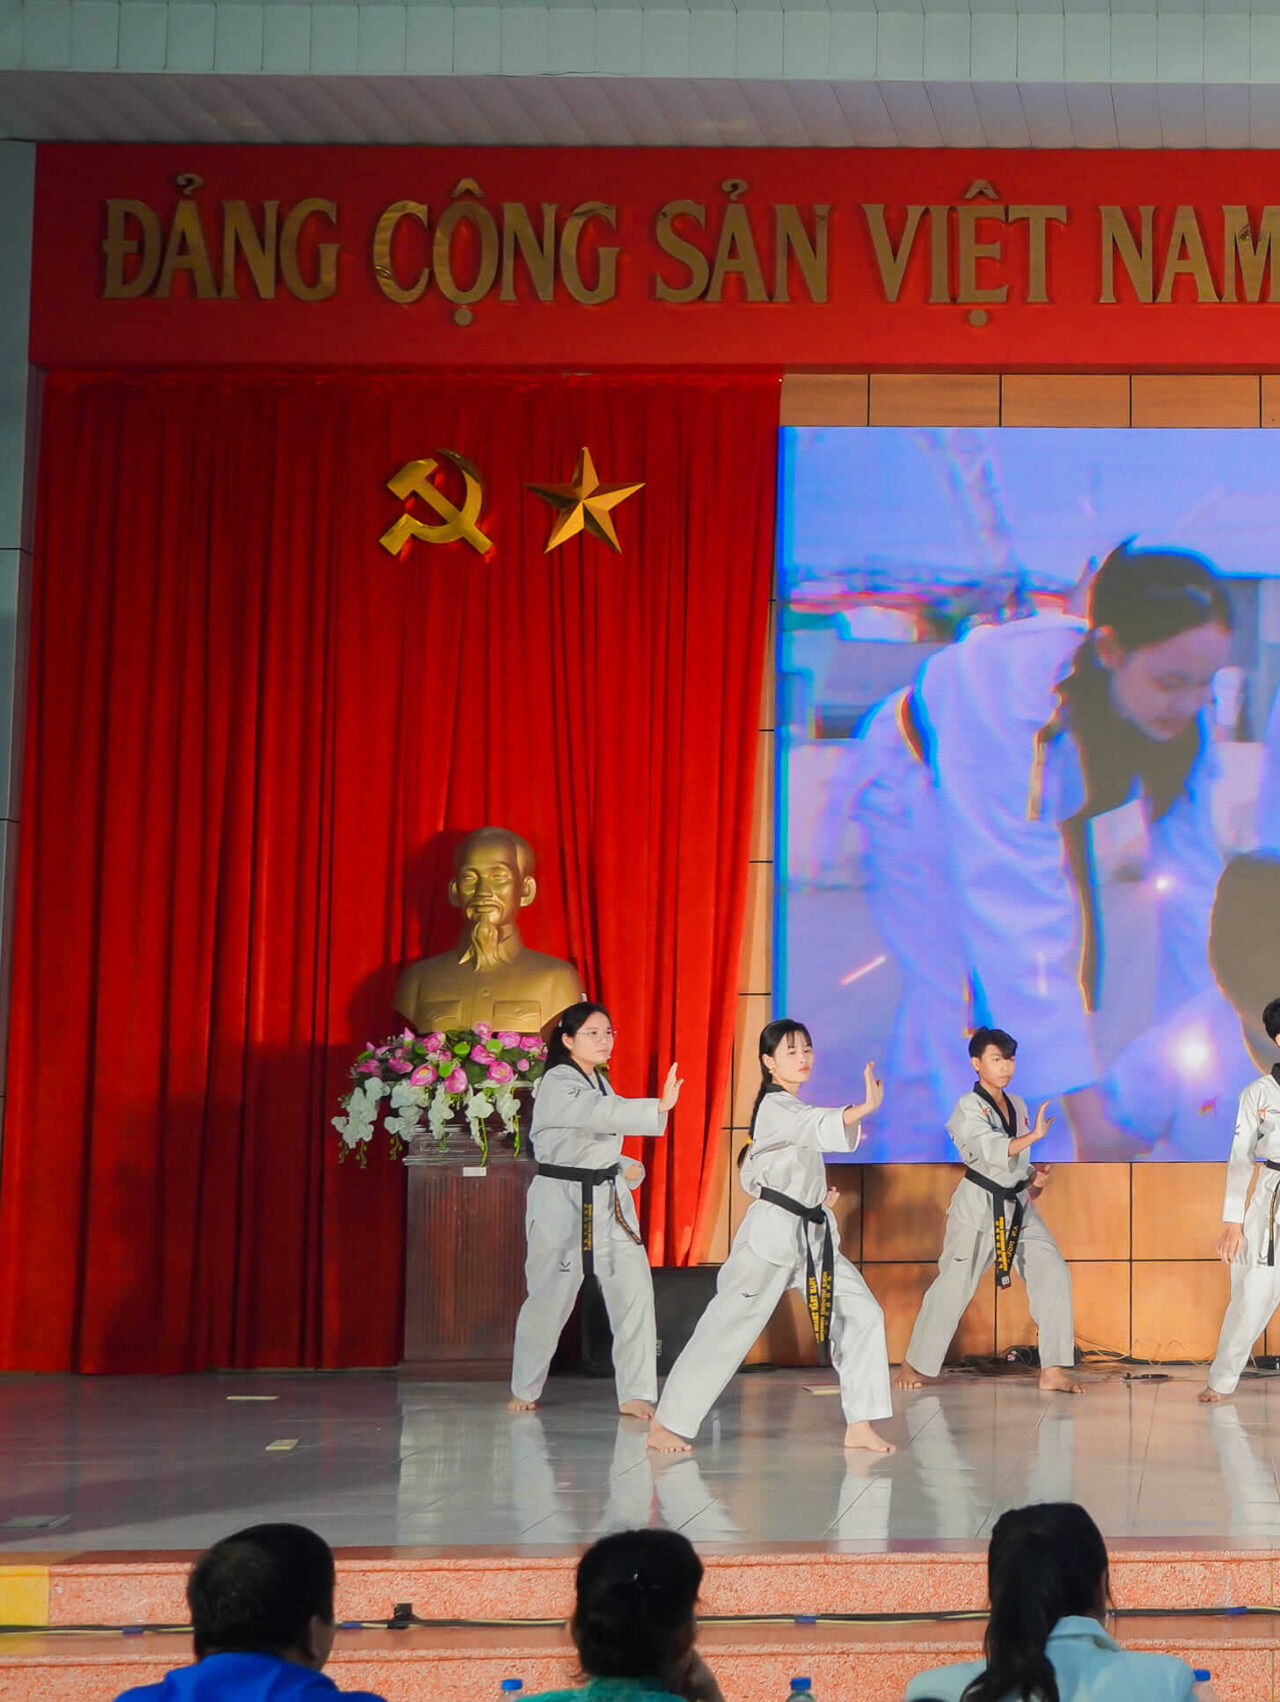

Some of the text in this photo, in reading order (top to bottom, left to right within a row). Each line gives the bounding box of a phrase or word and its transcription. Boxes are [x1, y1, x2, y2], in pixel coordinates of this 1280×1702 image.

[101, 172, 339, 302] ĐẢNG
[373, 178, 619, 327] CỘNG
[655, 178, 830, 303] SẢN
[862, 179, 1067, 327] VIỆT
